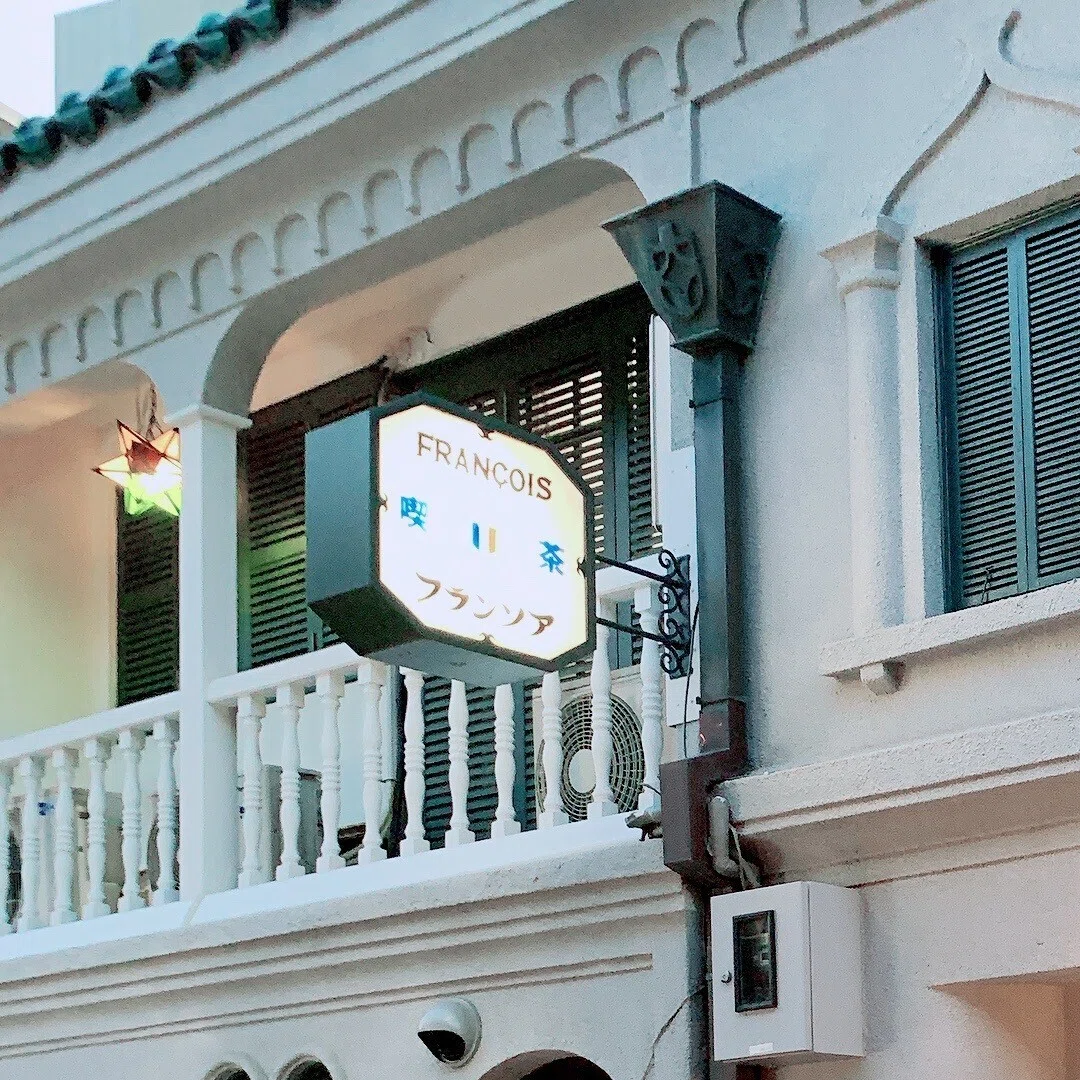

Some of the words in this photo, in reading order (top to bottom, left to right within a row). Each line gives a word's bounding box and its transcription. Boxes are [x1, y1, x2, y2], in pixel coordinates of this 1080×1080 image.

[417, 431, 552, 501] FRANÇOIS
[415, 571, 555, 636] フランソア
